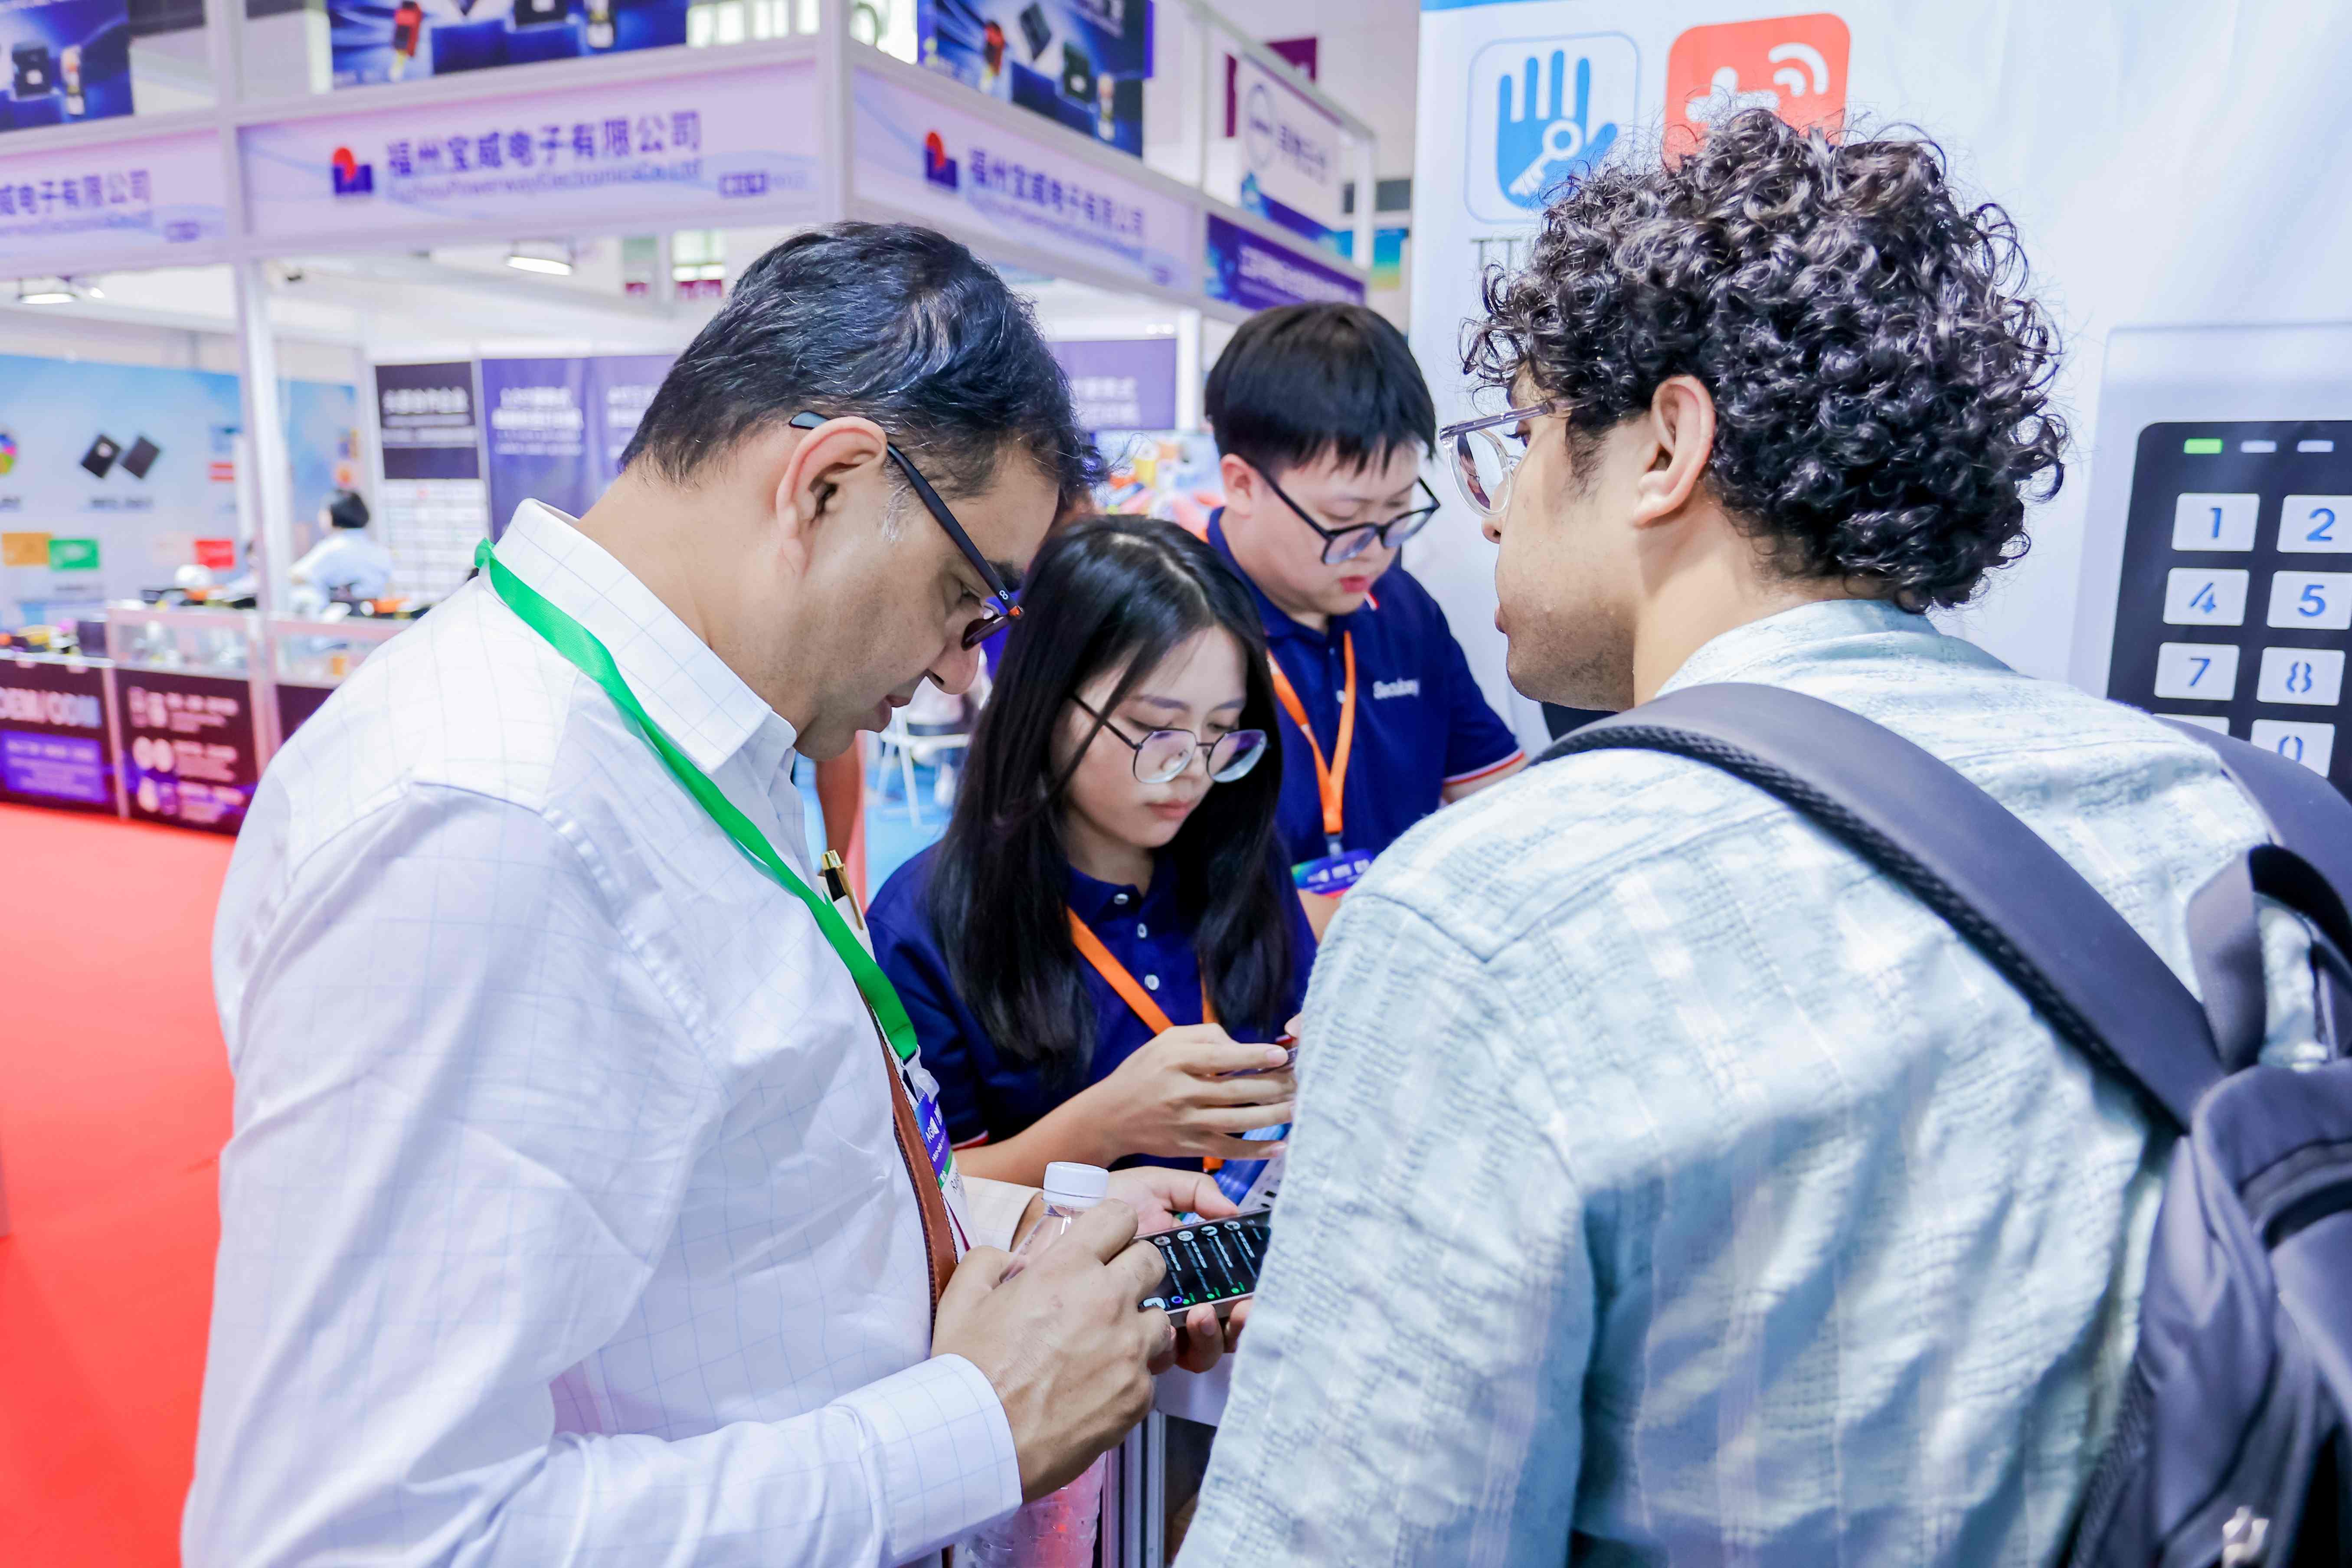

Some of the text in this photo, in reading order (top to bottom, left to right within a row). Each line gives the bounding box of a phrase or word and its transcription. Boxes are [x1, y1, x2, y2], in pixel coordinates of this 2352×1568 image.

[2210, 507, 2336, 542] 1 2
[2189, 582, 2326, 617] 4 5
[2189, 658, 2313, 694] 7 8
[2278, 736, 2304, 765] 0
